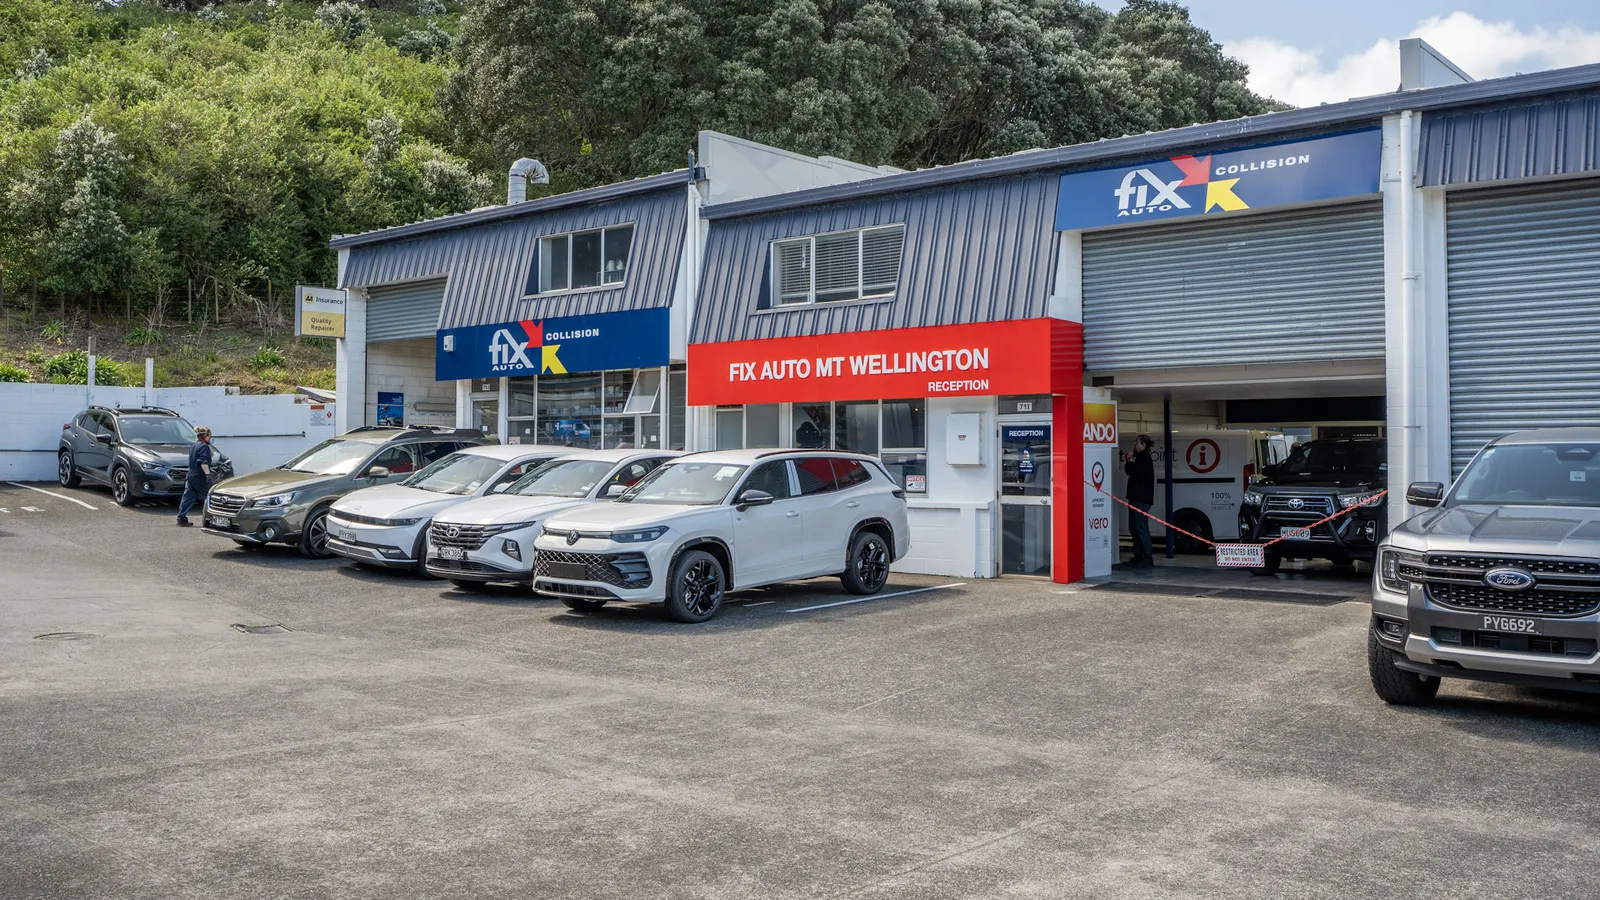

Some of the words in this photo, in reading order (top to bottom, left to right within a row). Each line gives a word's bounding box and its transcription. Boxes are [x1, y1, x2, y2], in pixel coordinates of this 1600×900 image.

[1215, 154, 1310, 176] COLLISION
[1117, 204, 1172, 217] AUTO
[315, 296, 344, 305] Insurance
[310, 317, 332, 325] Quality
[310, 324, 335, 332] Repairer
[545, 328, 600, 341] COLLISION
[491, 363, 524, 372] AUTO
[729, 361, 757, 383] FIX
[760, 358, 811, 381] AUTO
[816, 356, 845, 378] MT
[849, 347, 990, 376] WELLINGTON
[928, 379, 990, 393] RECEPTION
[1083, 423, 1116, 442] ANDO
[1211, 492, 1232, 500] 100%
[1088, 517, 1109, 530] vero
[1220, 547, 1246, 556] RESTRICTED
[1247, 548, 1259, 556] AREA
[1496, 573, 1521, 585] Ford
[1483, 616, 1535, 632] PYG692
